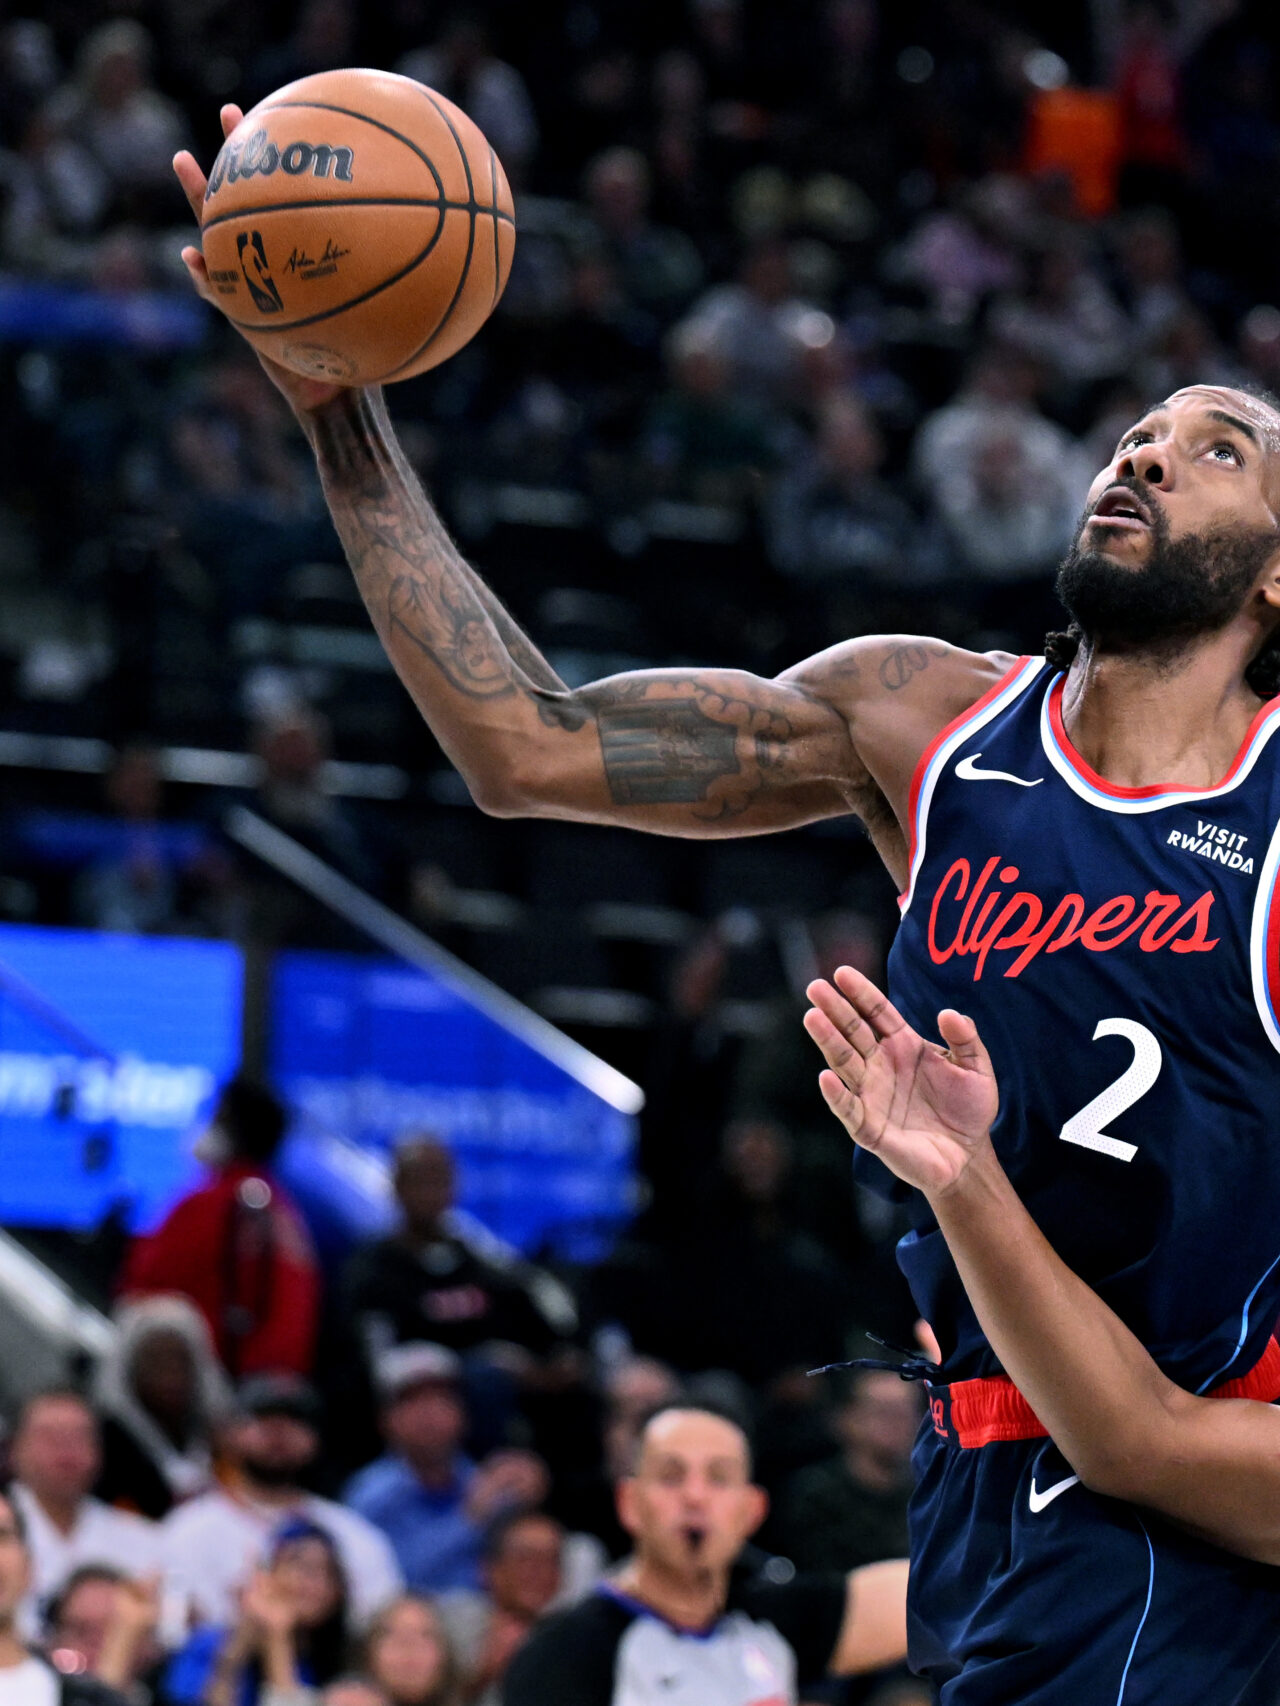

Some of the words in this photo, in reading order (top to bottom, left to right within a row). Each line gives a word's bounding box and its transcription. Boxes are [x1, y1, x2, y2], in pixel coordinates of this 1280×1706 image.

[1166, 830, 1254, 875] RWANDA
[1197, 820, 1248, 851] VISIT
[928, 856, 1221, 981] Clippers
[1059, 1017, 1163, 1162] 2
